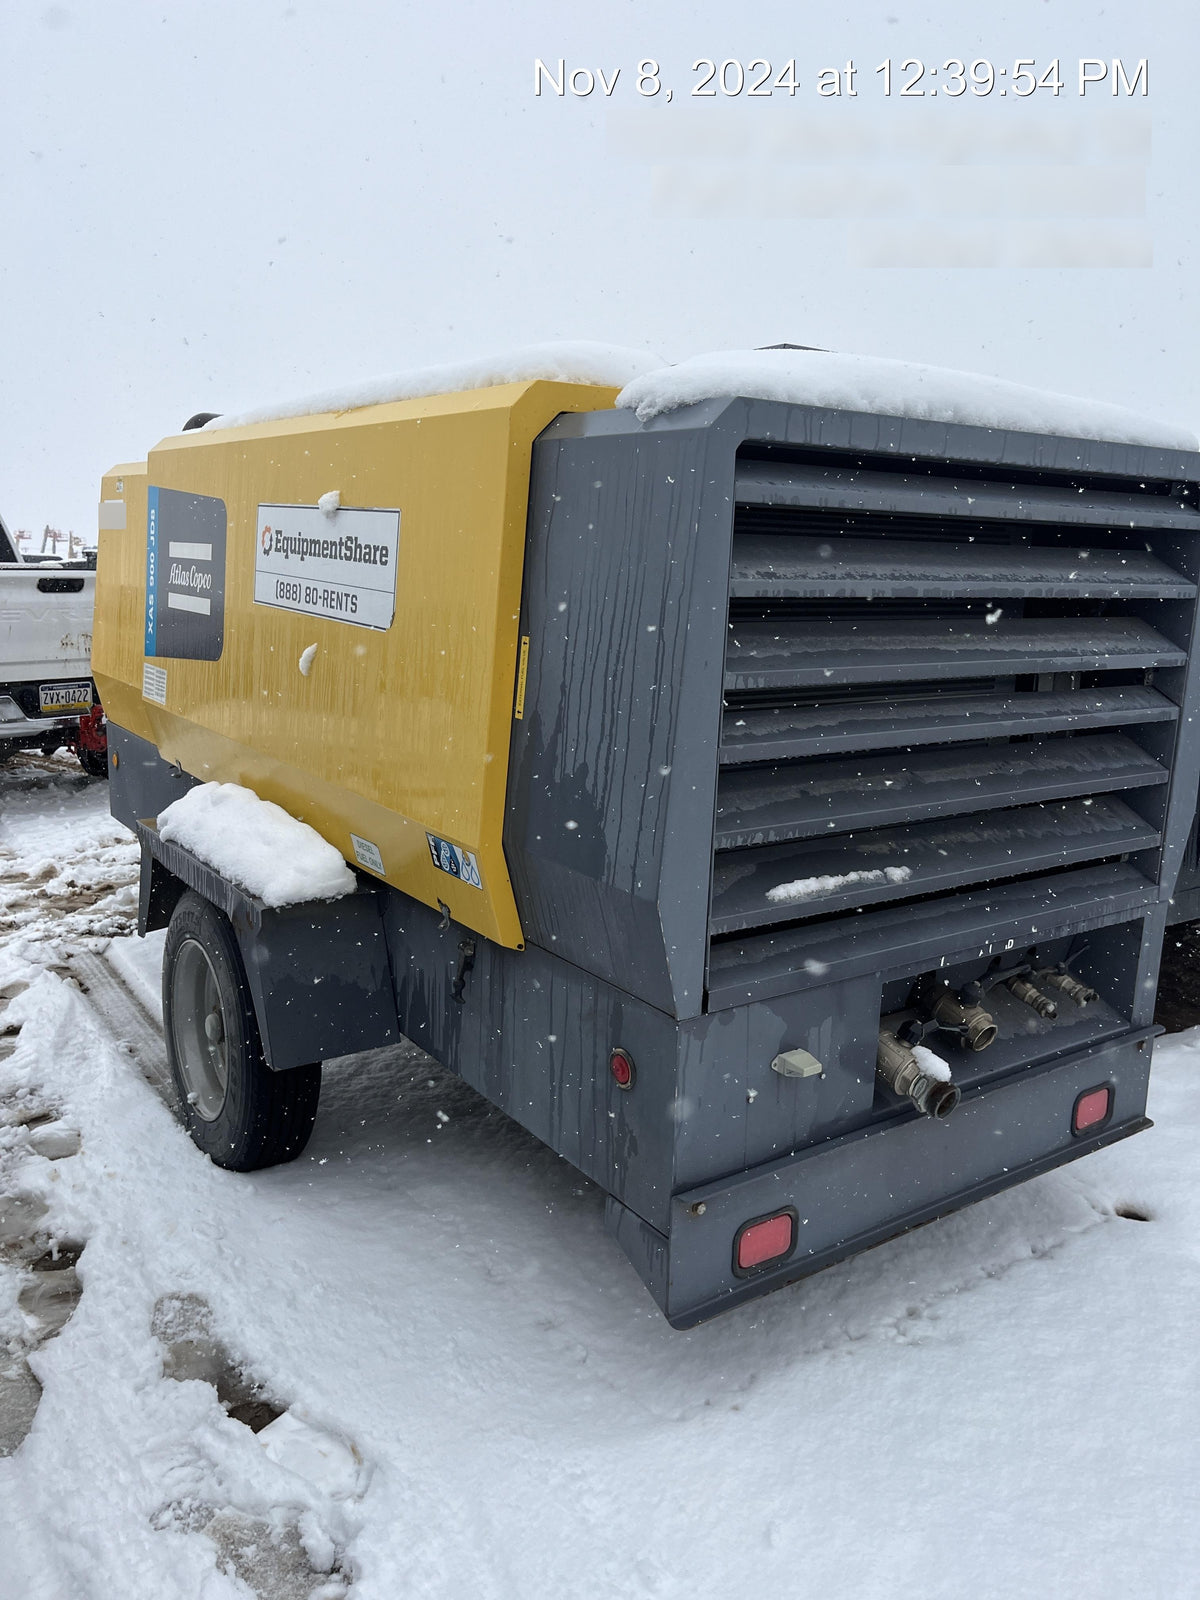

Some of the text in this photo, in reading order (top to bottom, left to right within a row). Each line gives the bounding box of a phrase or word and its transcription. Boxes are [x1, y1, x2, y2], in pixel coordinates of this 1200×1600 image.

[275, 530, 389, 566] EquipmentShare
[168, 563, 213, 592] Atlas Copco
[275, 579, 358, 614] (888) 80-RENTS
[147, 594, 155, 635] XAS
